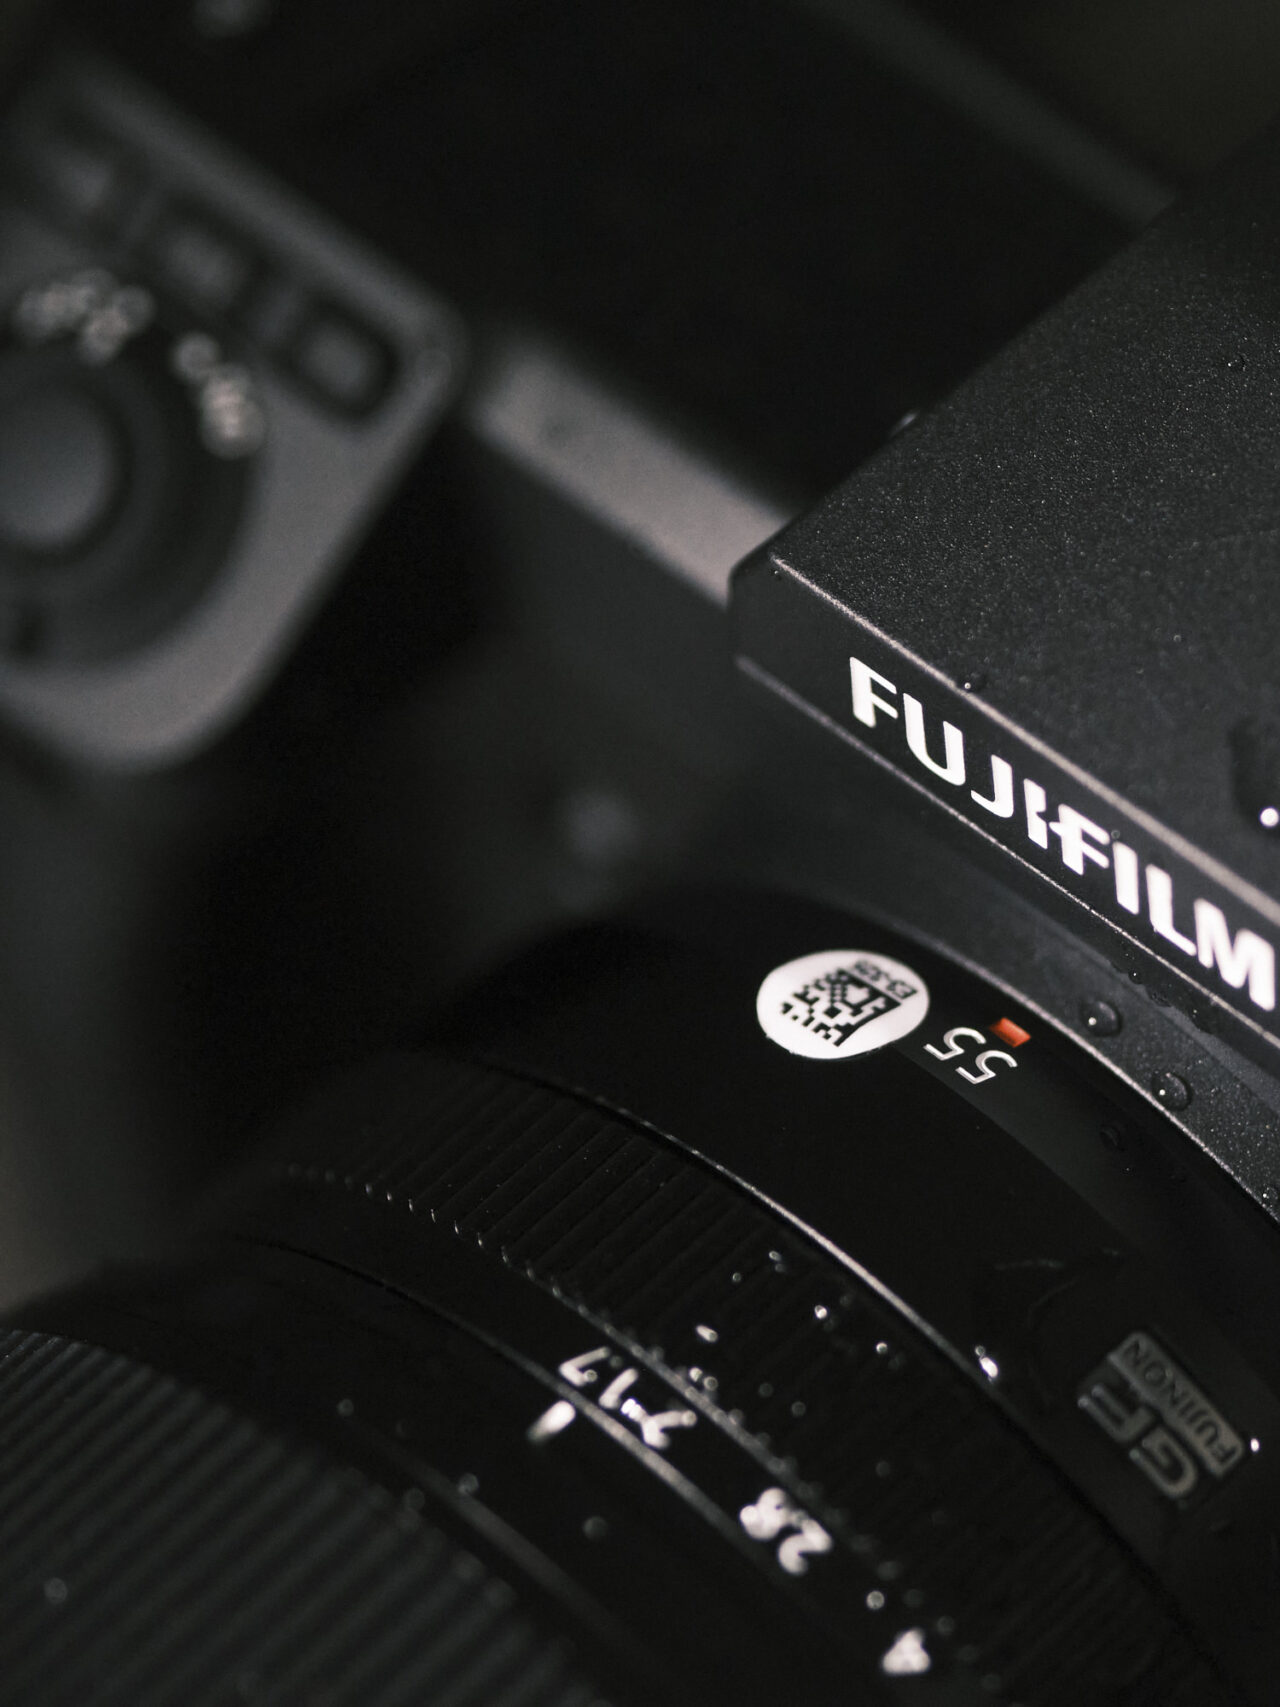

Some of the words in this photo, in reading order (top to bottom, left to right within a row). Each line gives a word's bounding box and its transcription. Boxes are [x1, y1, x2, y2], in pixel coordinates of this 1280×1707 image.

[849, 656, 1276, 1012] FUJIFILM
[923, 1027, 1018, 1084] 55
[1077, 1384, 1198, 1498] GF
[1120, 1338, 1239, 1464] FUJINON
